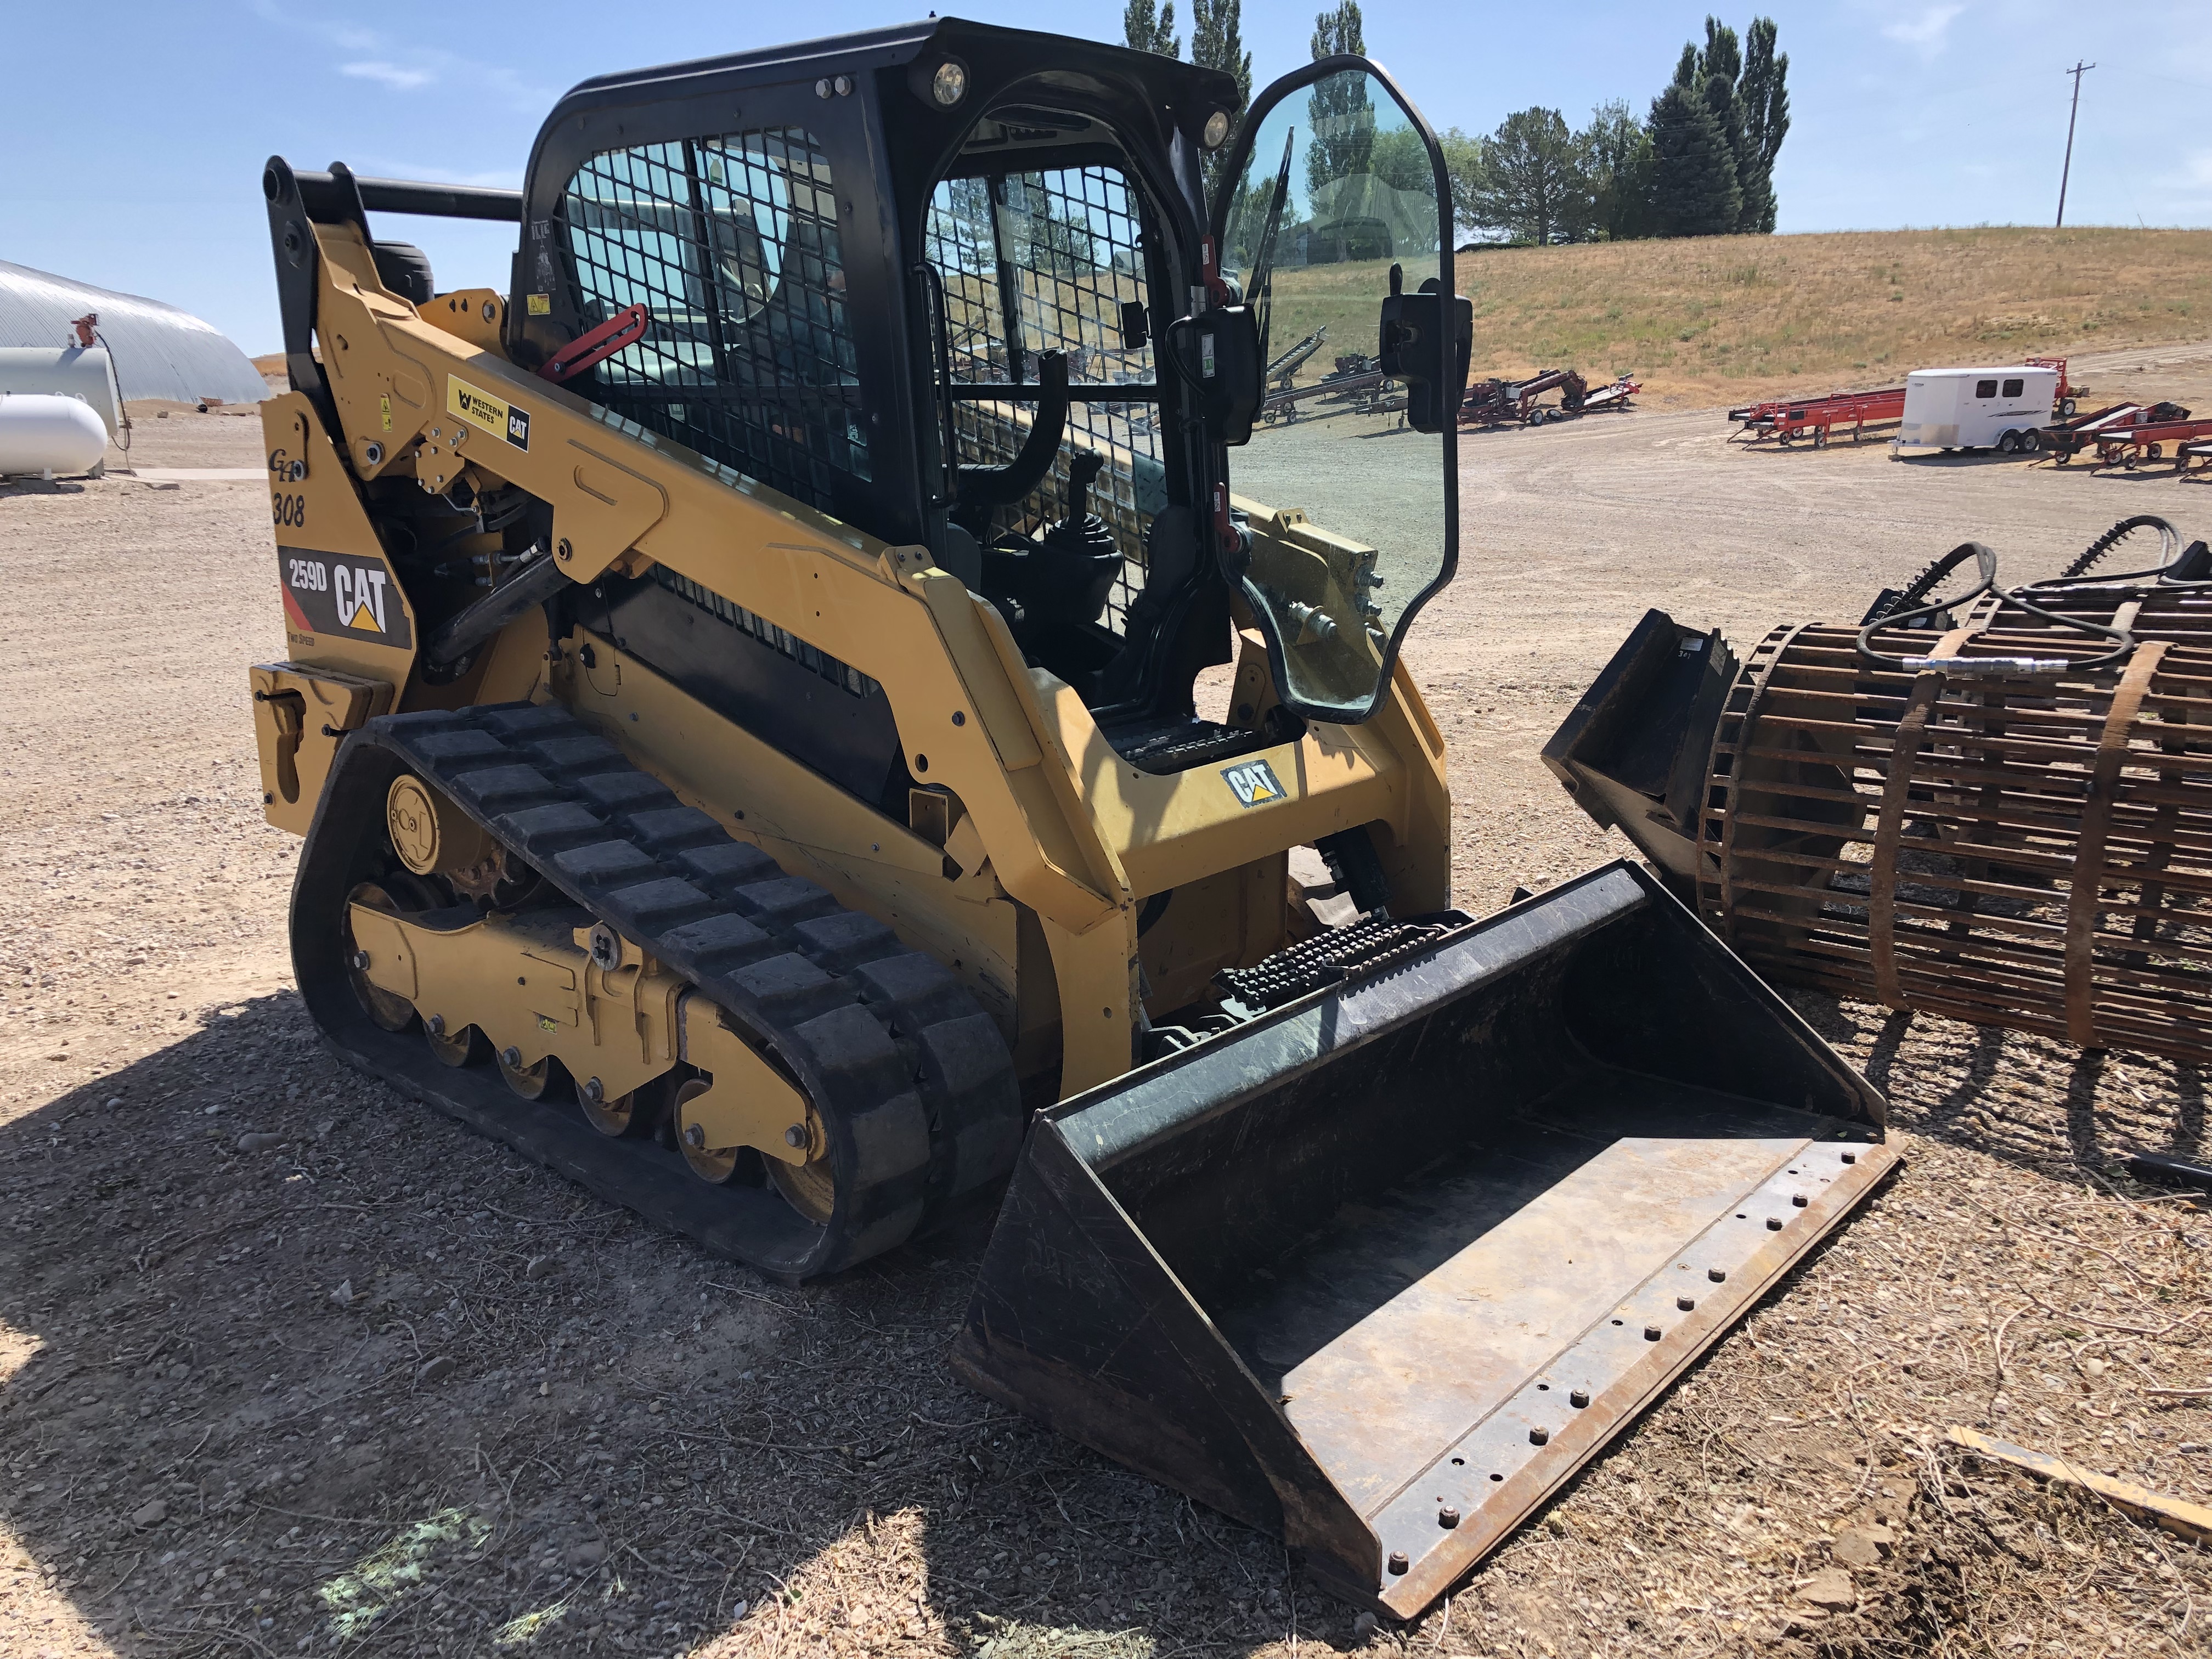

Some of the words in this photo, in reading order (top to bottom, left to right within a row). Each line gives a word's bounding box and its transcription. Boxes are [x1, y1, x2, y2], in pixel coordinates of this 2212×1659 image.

[471, 407, 494, 424] STATES
[472, 396, 503, 419] WESTERN
[509, 415, 527, 440] CAT
[273, 492, 305, 528] 308
[289, 558, 328, 592] 259D
[334, 564, 386, 634] CAT
[1227, 764, 1278, 803] CAT
